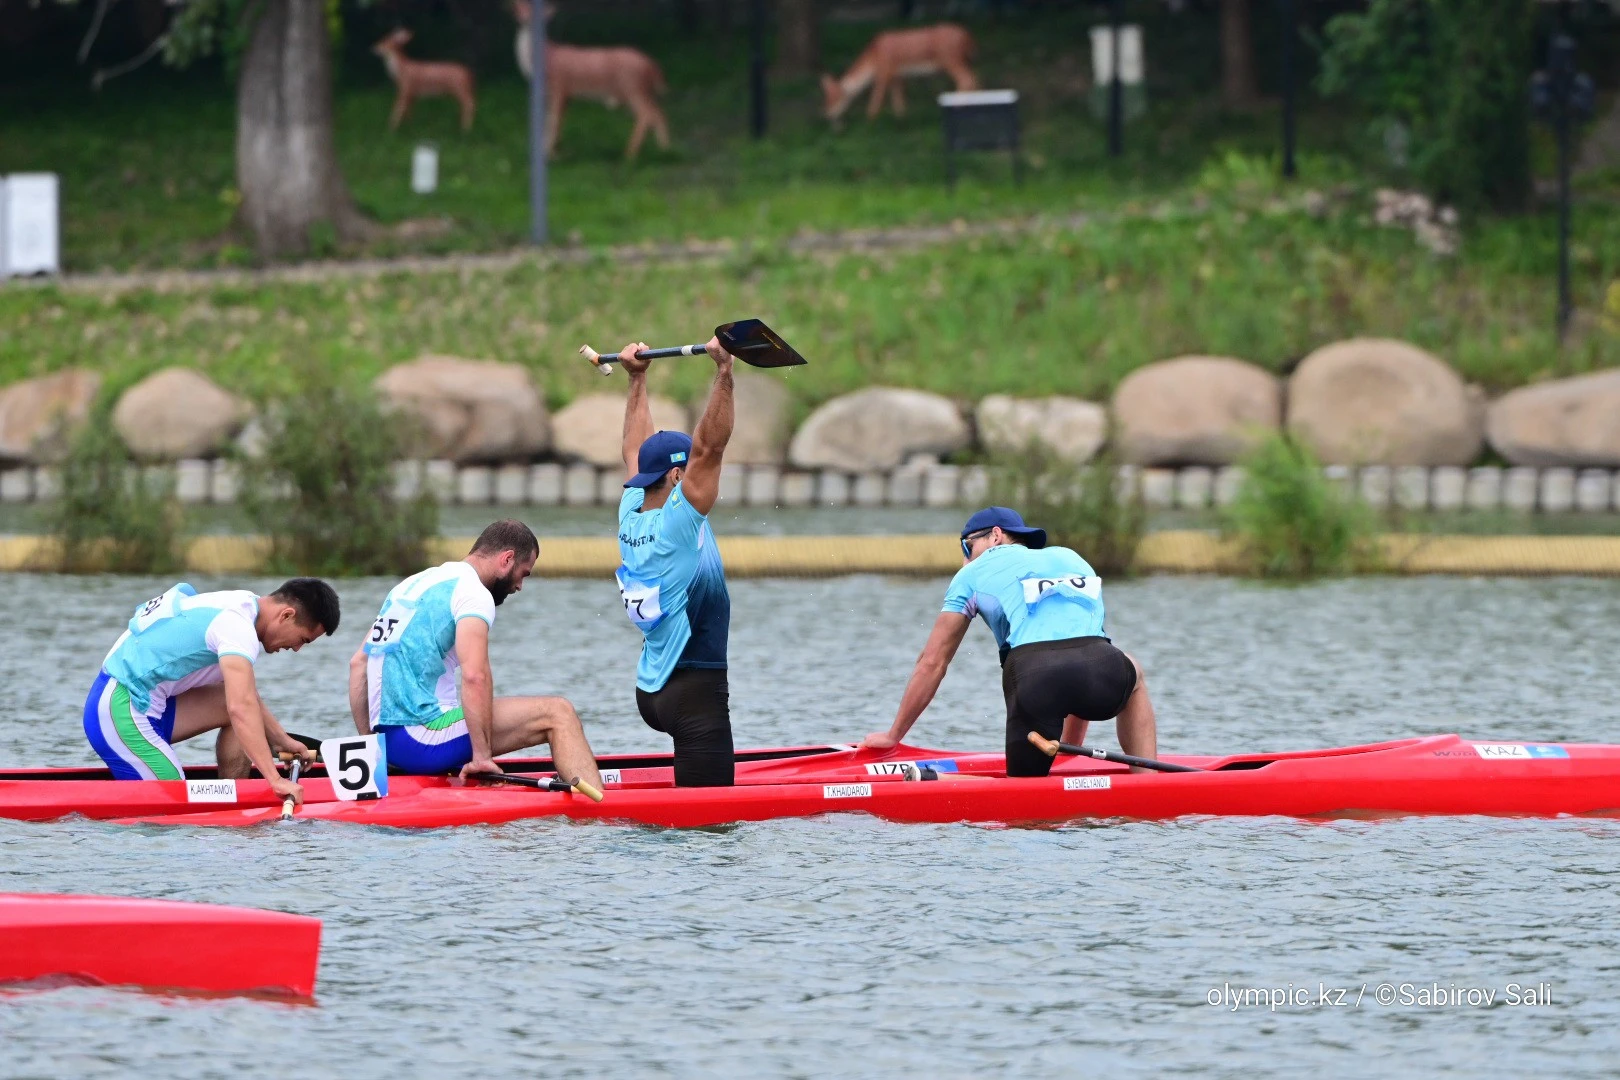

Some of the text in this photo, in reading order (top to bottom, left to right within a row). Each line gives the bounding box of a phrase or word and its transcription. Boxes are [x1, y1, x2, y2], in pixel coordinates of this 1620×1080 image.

[1482, 745, 1523, 756] KAZ
[338, 740, 370, 791] 5
[826, 785, 869, 797] T.KHAIDAROV
